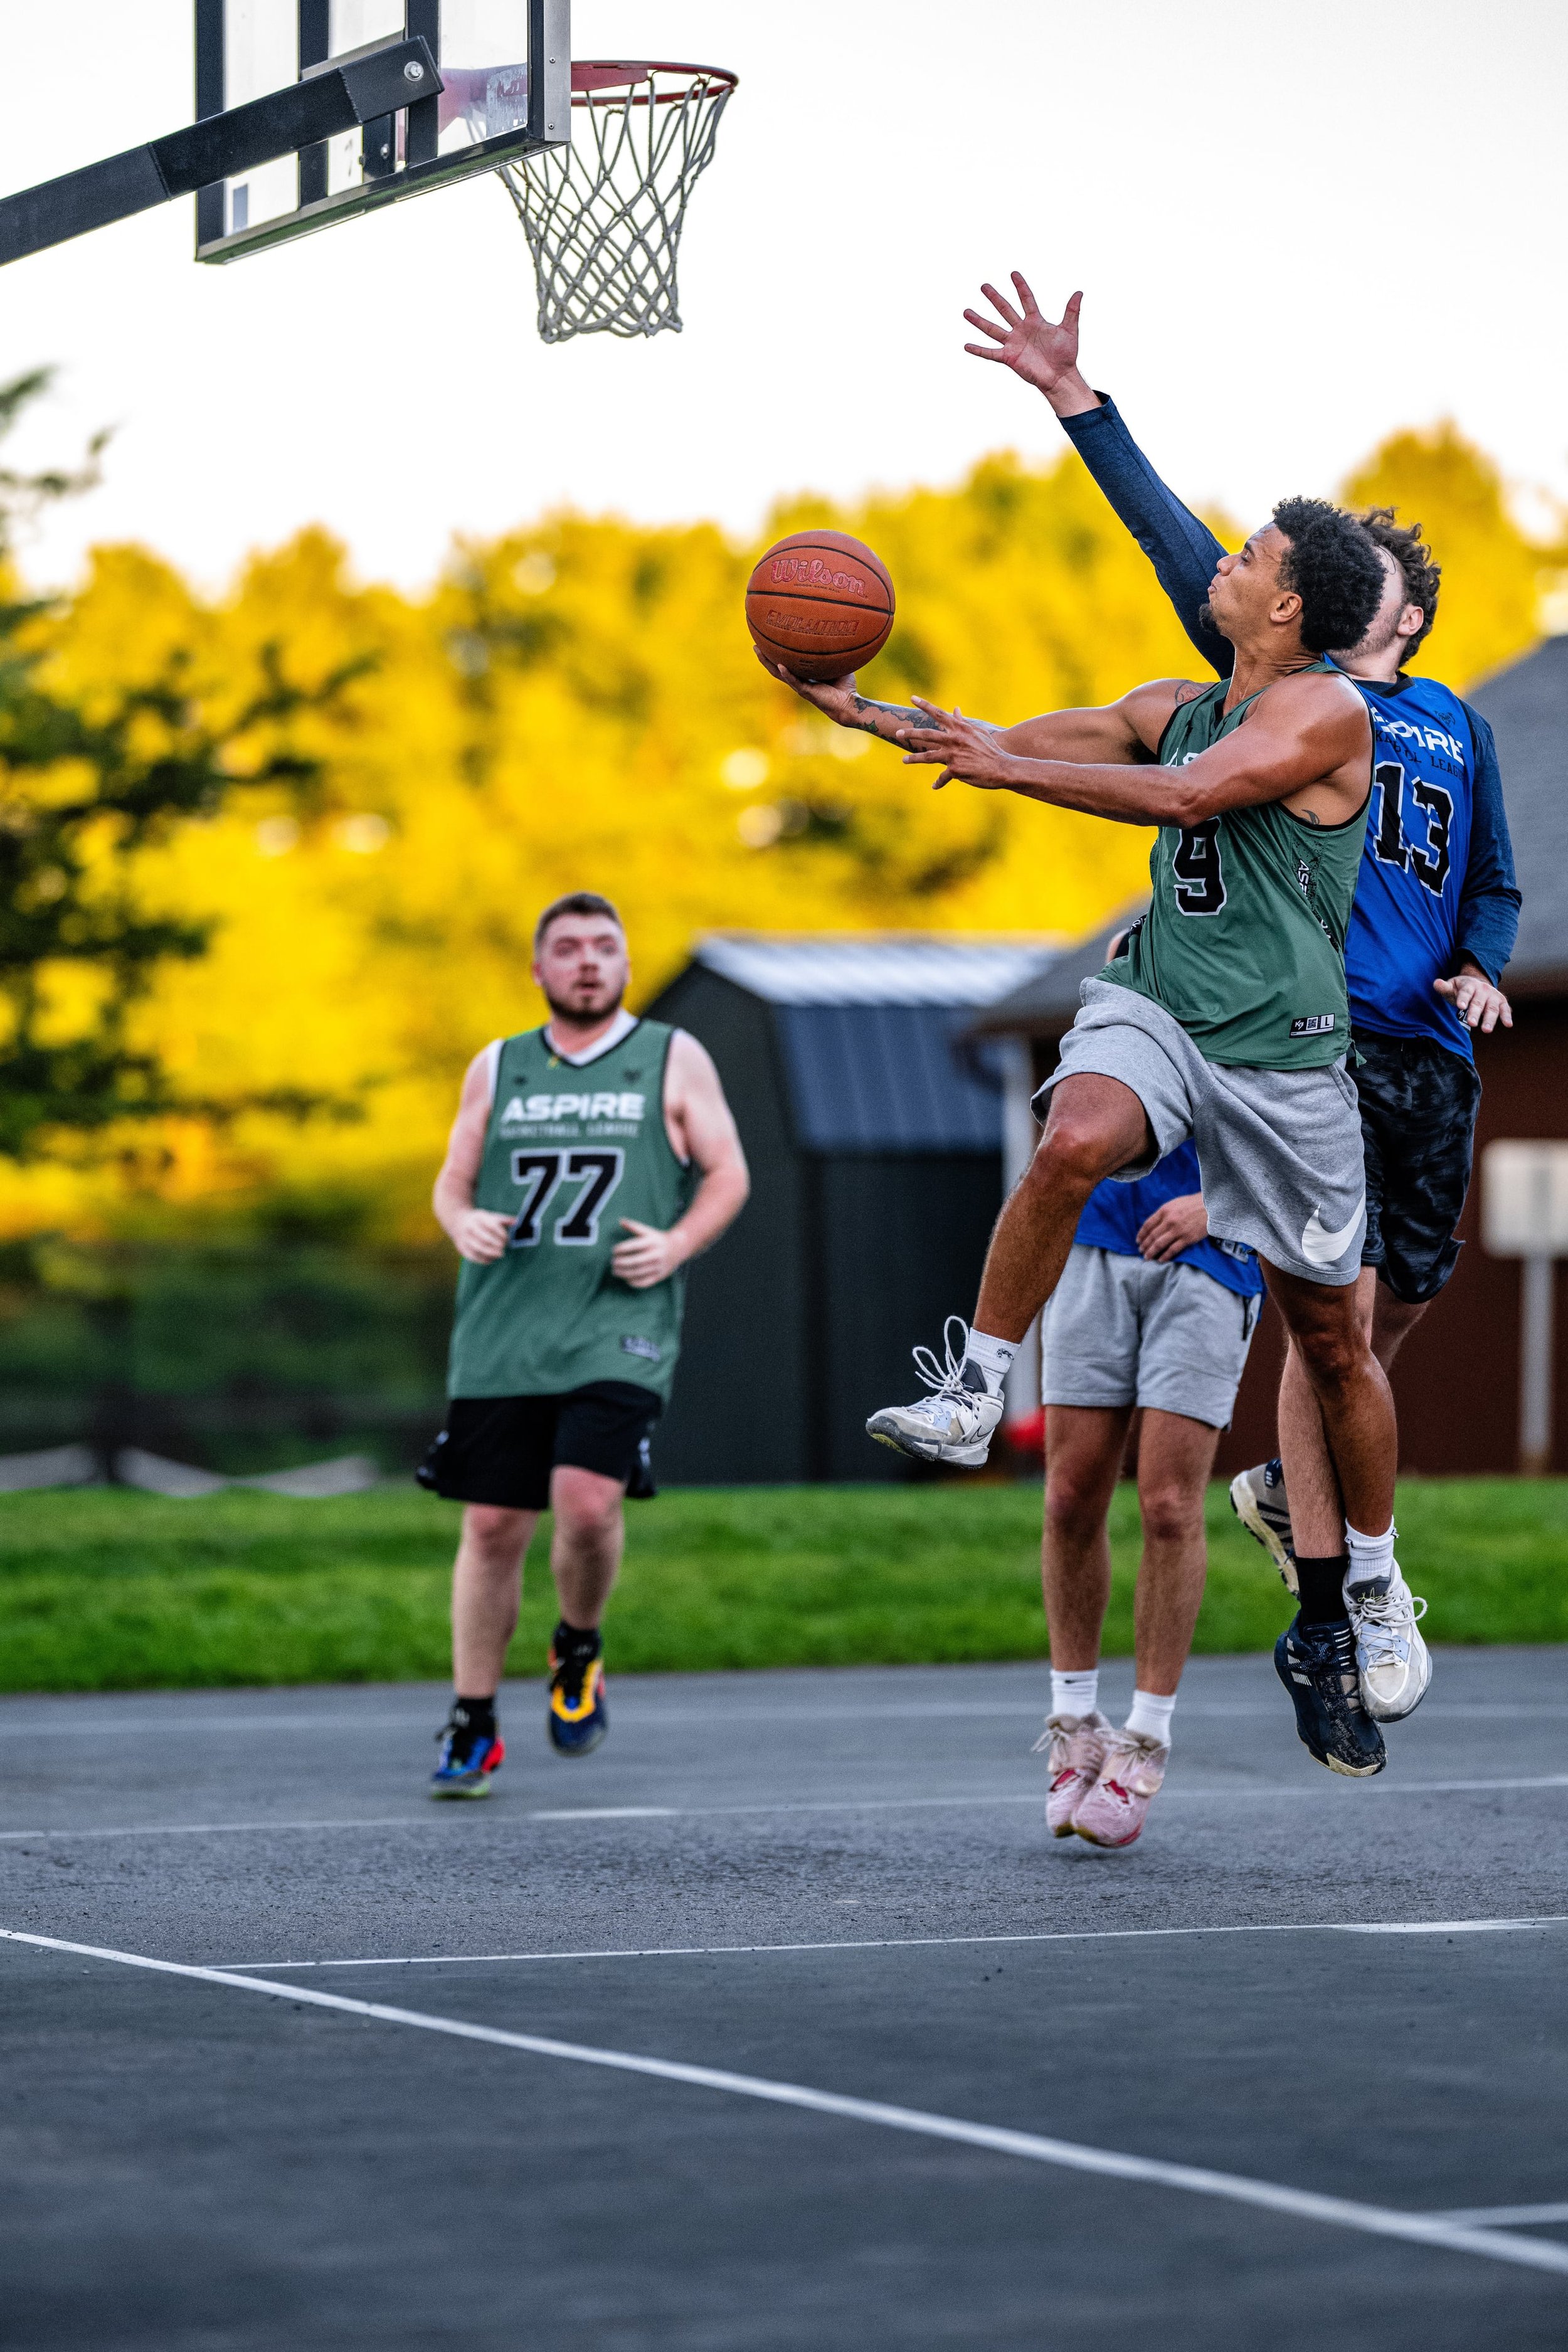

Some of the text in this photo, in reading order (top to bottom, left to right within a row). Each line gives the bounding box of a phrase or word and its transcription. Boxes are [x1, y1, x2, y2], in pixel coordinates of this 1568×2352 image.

[770, 558, 867, 597] Wilson
[1370, 706, 1465, 766] SPIRE
[1374, 761, 1454, 898] 13
[1172, 815, 1227, 916] 9
[1325, 1016, 1330, 1026] L
[501, 1091, 645, 1125] ASPIRE
[509, 1147, 625, 1248] 77
